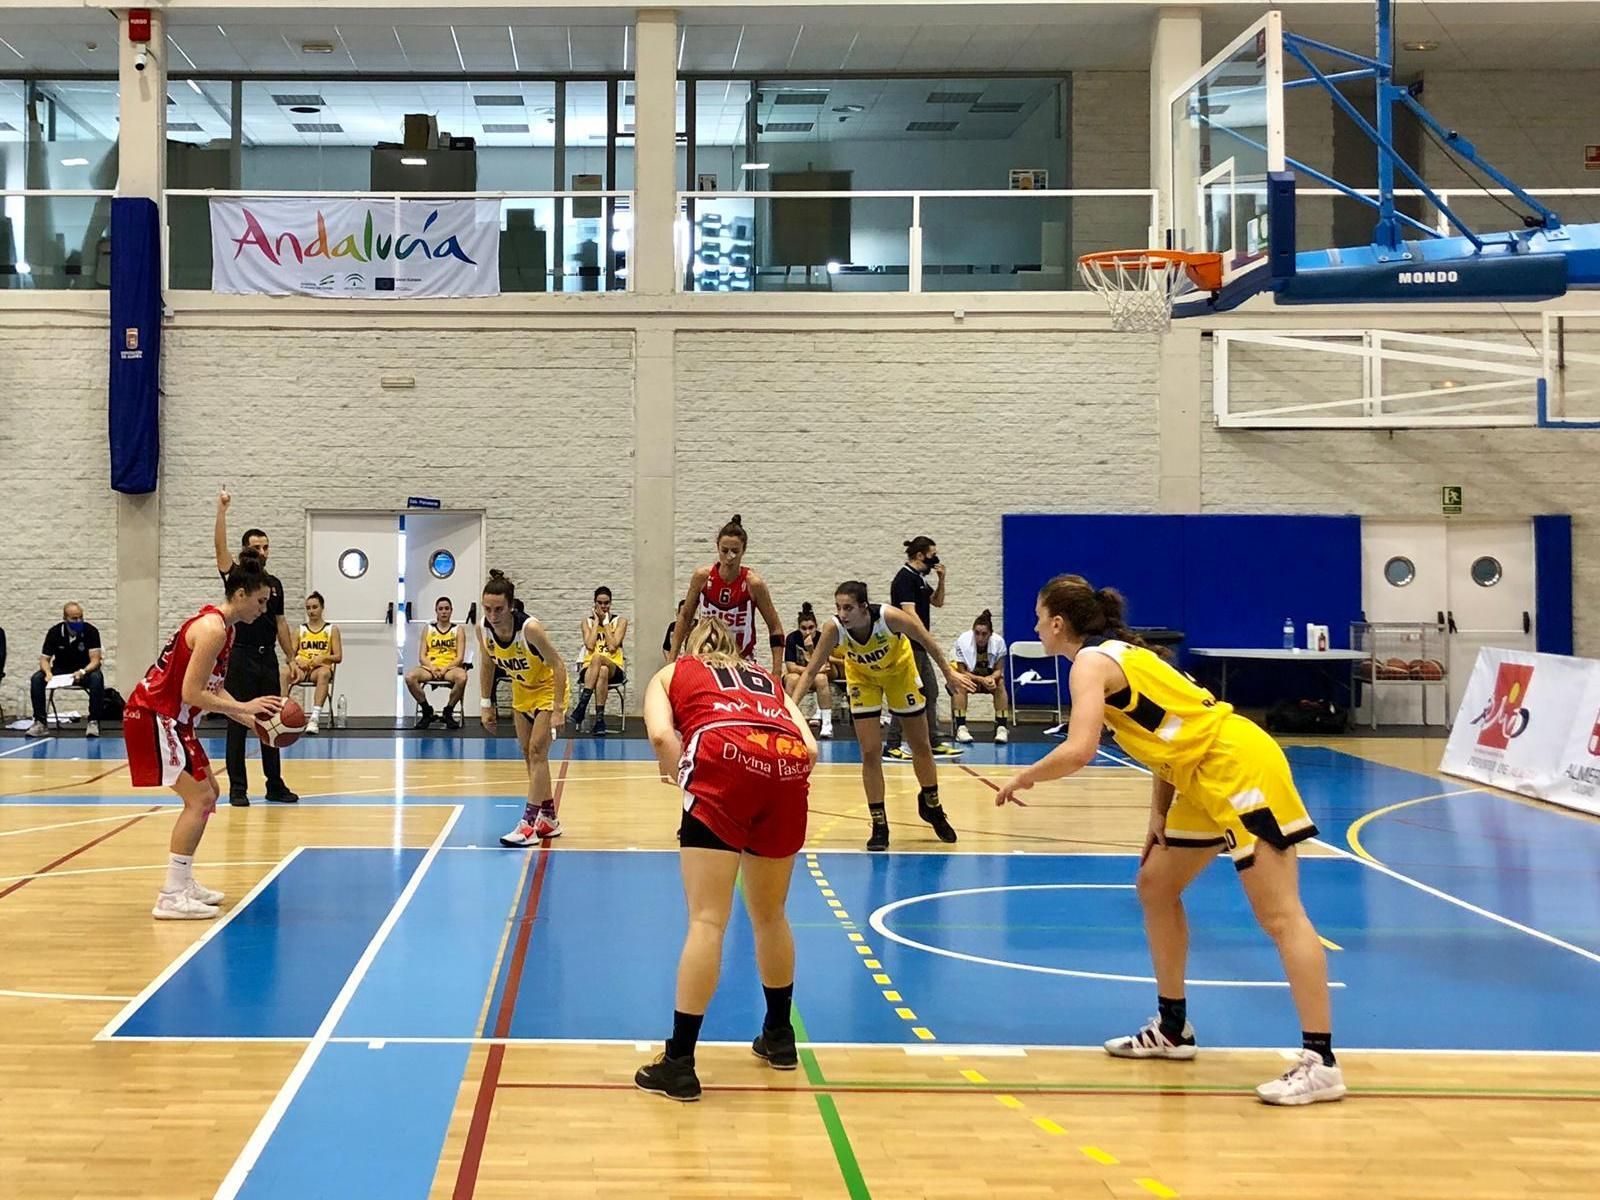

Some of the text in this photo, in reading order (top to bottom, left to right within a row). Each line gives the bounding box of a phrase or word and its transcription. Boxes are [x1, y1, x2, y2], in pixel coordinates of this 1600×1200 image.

[231, 207, 478, 266] Andalucía
[1398, 271, 1458, 284] MONDO
[719, 588, 731, 605] 6
[431, 639, 456, 648] CANOE
[906, 693, 917, 706] 6
[722, 742, 772, 774] Divina
